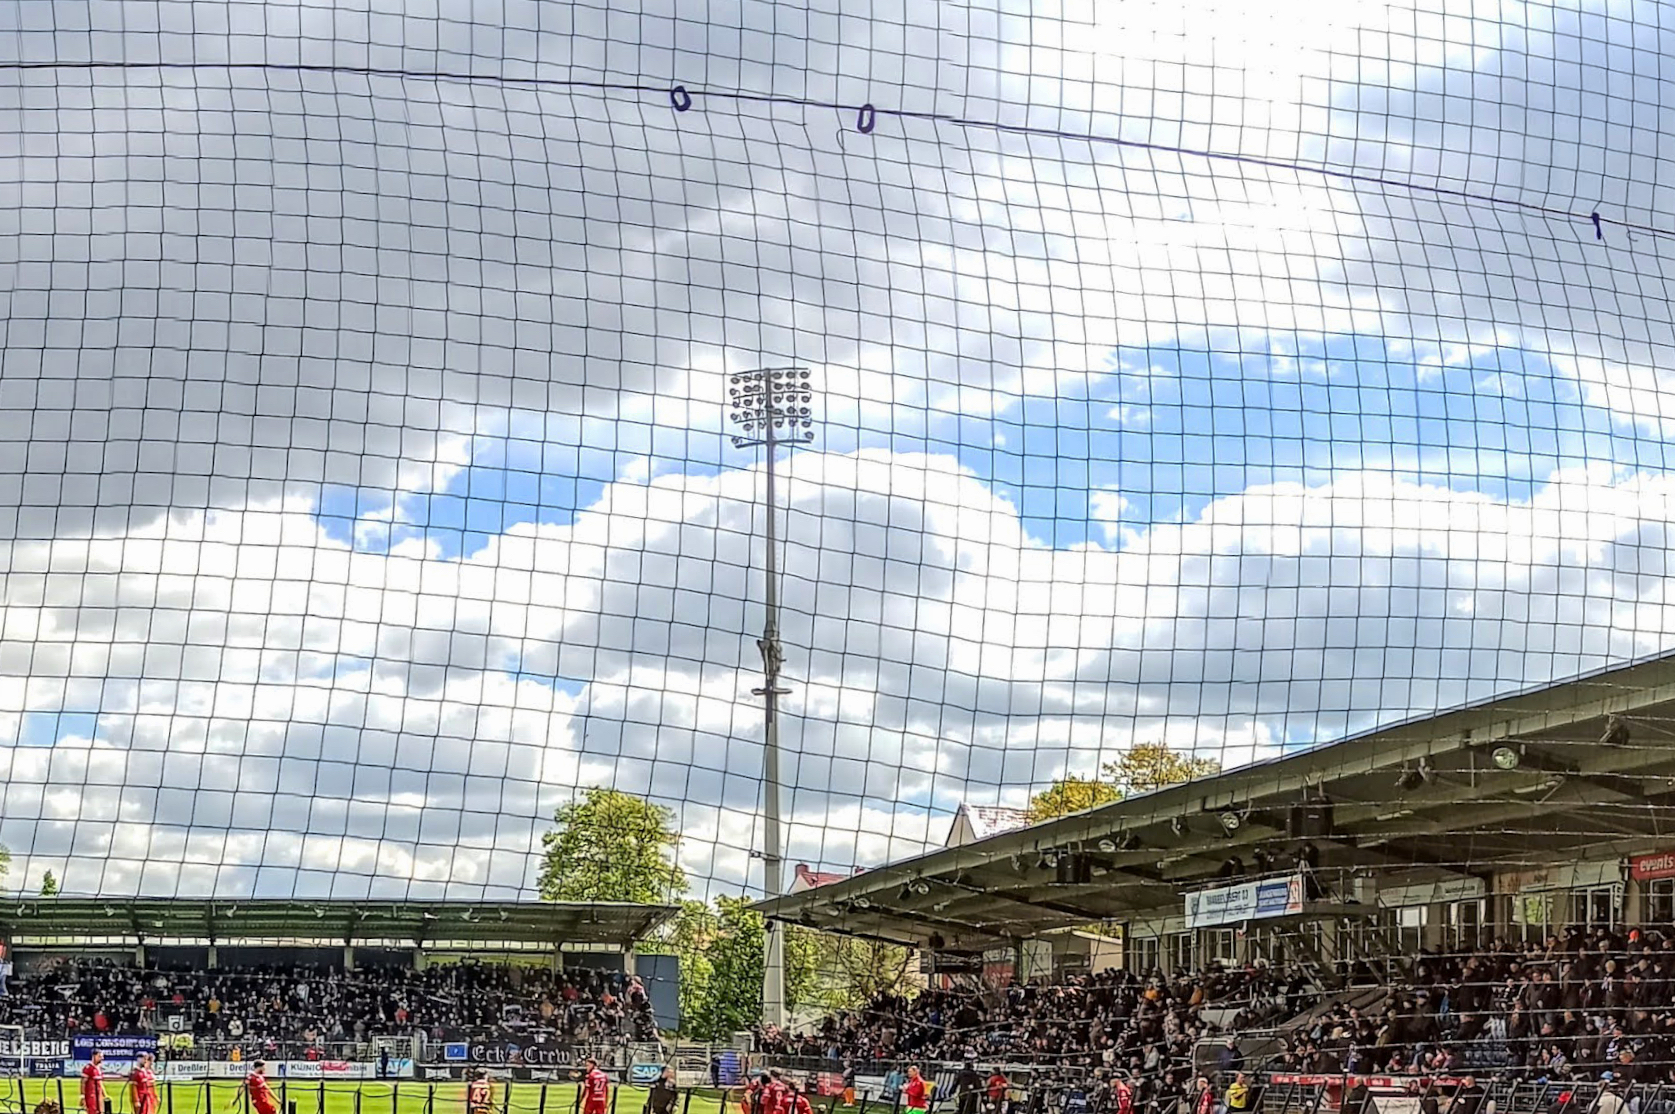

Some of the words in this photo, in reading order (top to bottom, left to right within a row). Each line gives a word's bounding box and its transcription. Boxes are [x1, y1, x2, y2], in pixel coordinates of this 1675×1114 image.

[1640, 854, 1675, 872] events
[524, 1044, 570, 1064] Crew
[177, 1063, 208, 1073] Dreßler
[632, 1066, 662, 1080] SAP
